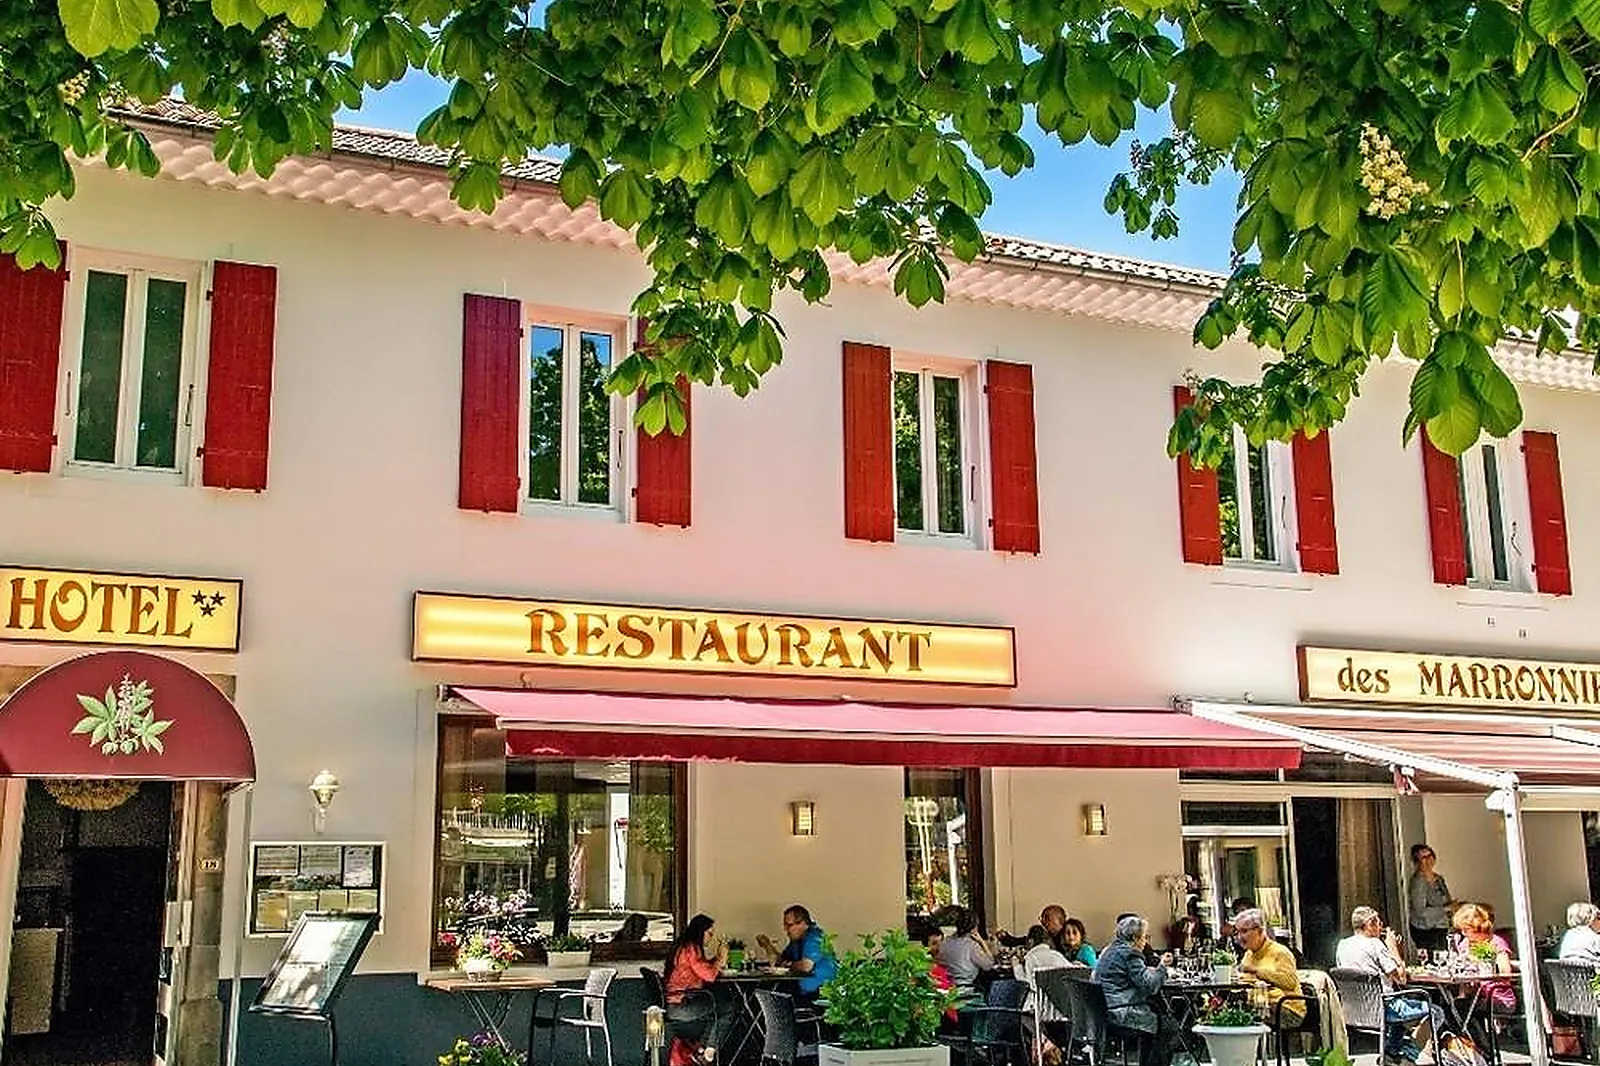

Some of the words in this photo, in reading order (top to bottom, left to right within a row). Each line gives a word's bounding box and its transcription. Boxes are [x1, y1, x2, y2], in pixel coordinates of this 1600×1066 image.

[6, 577, 193, 638] HOTEL
[524, 608, 932, 673] RESTAURANT
[1337, 657, 1390, 694] des
